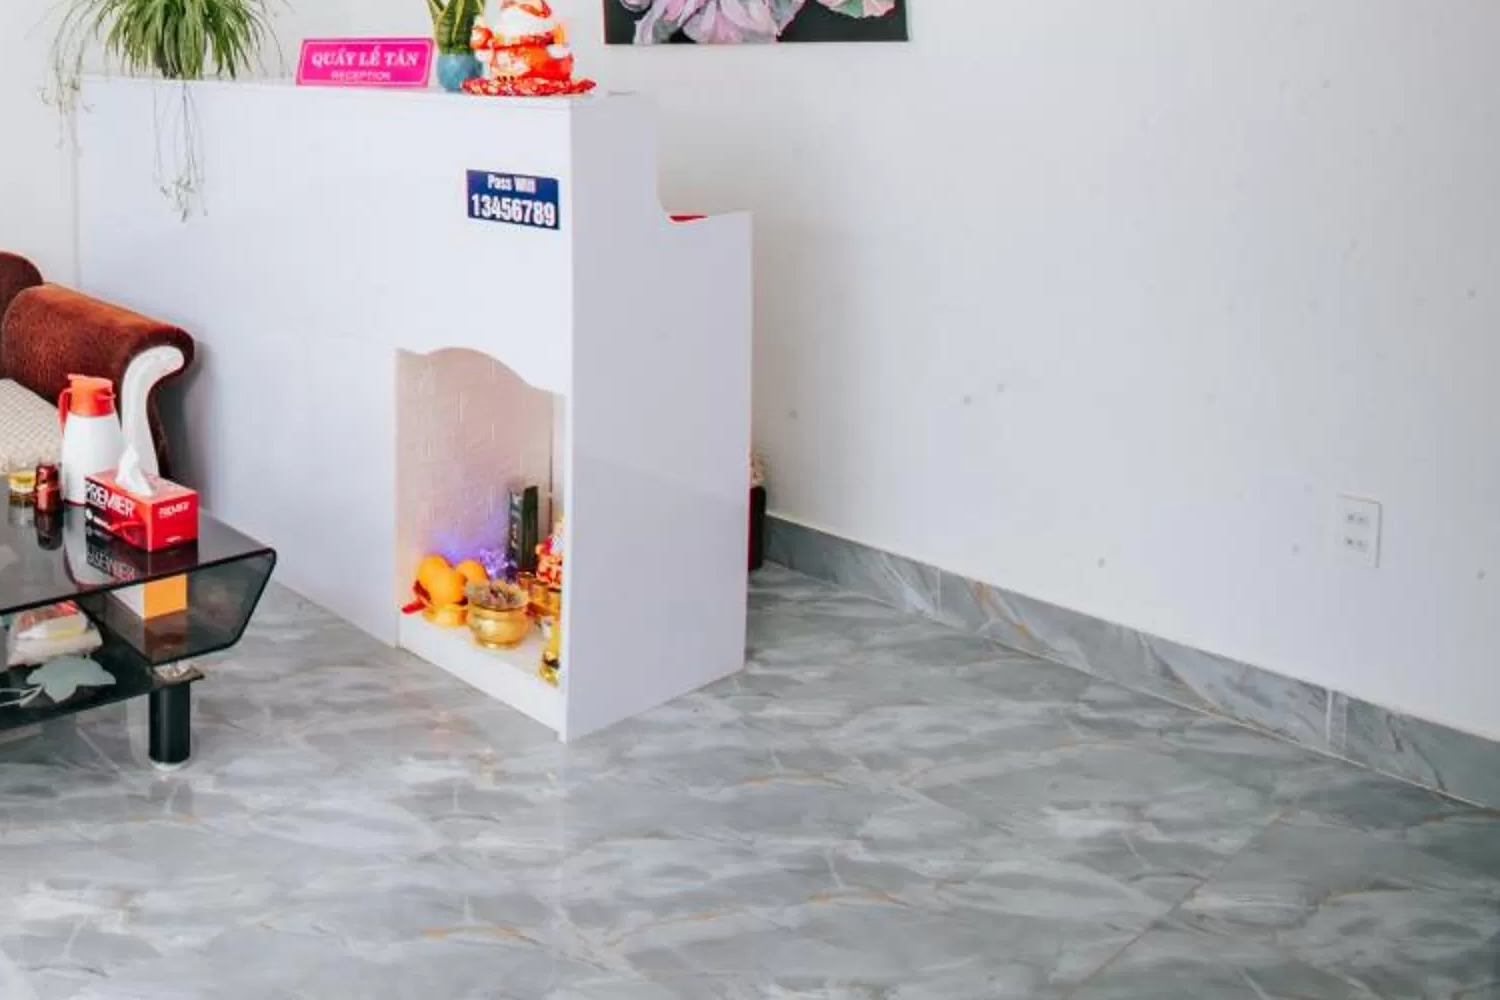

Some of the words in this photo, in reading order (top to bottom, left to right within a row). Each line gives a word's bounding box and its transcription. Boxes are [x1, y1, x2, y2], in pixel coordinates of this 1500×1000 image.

[330, 71, 391, 81] RECEPTION
[487, 173, 512, 191] Pass
[471, 193, 555, 226] 13456789
[84, 481, 135, 518] PREMIER
